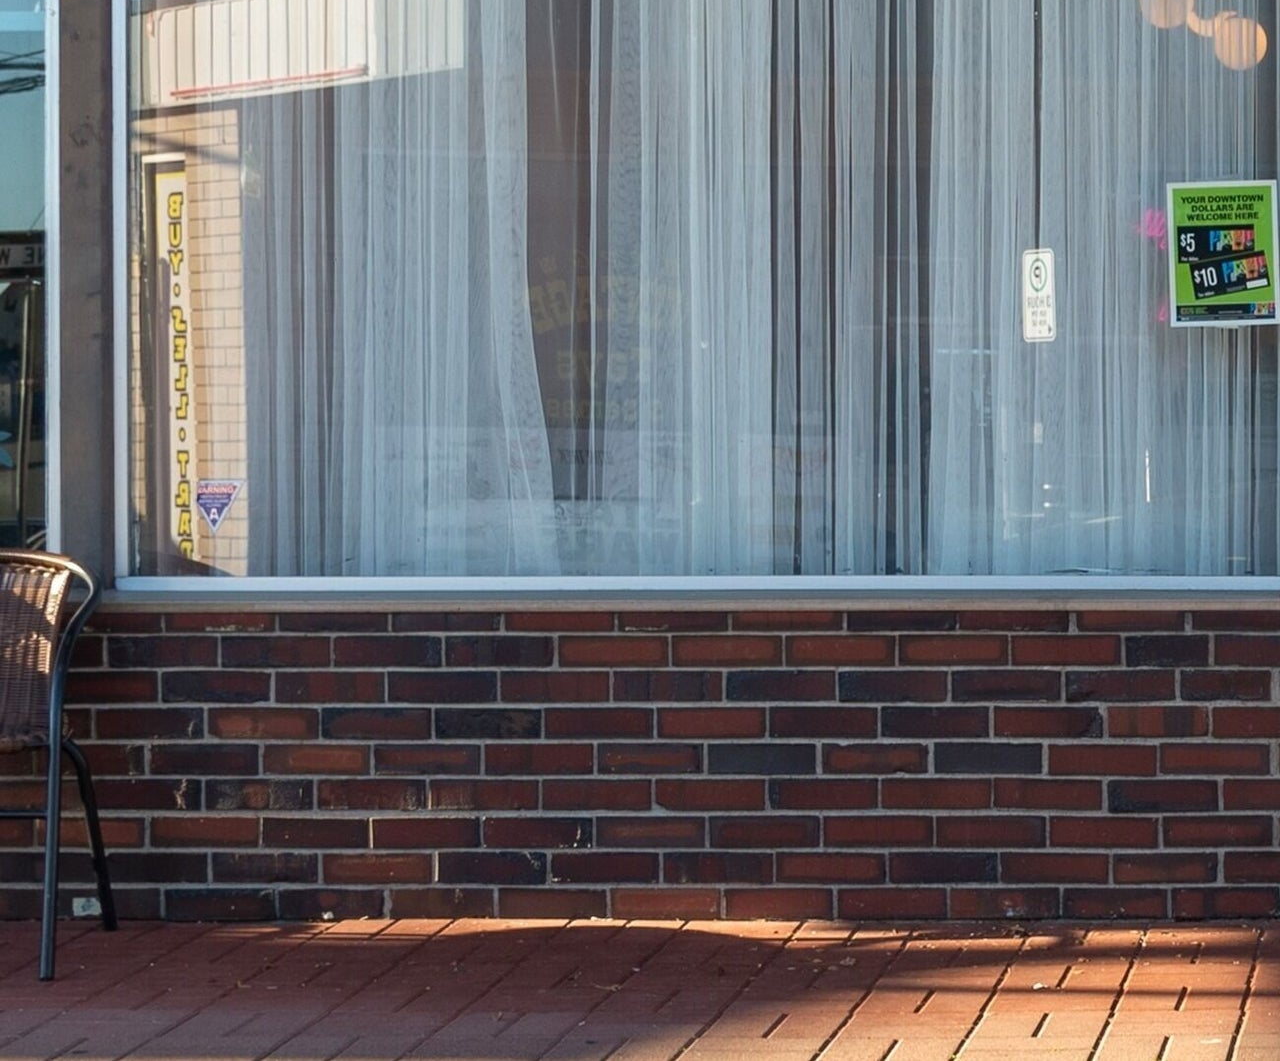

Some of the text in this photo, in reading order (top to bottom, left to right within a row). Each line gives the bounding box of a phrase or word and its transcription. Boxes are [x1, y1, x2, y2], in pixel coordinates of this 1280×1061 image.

[1180, 194, 1264, 204] YOUR DOWNTOWN
[1191, 203, 1255, 212] DOLLARS ARE
[1186, 211, 1260, 222] WELCOME HERE
[1180, 232, 1196, 253] $5
[1193, 266, 1218, 288] $10
